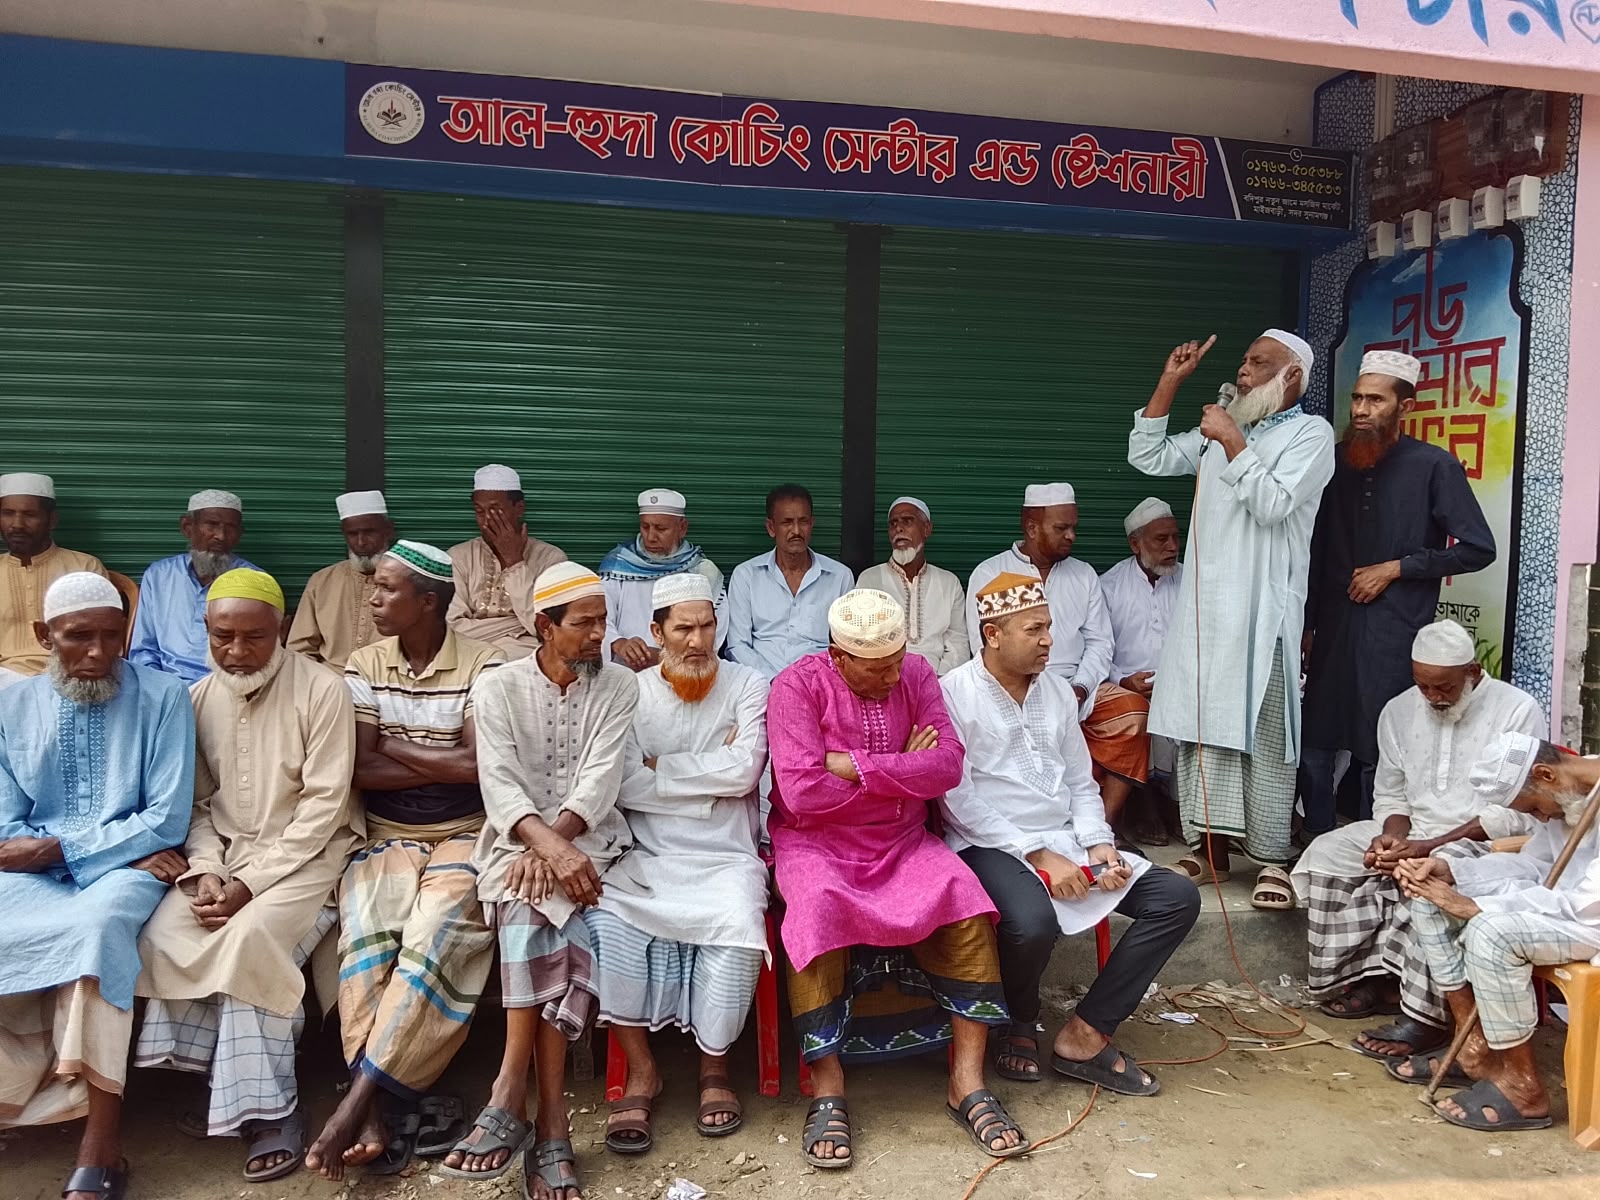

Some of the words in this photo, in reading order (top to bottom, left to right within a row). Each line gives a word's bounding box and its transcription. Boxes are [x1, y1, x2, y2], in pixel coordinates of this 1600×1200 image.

[437, 95, 658, 160] আল-হুদা
[669, 102, 811, 171] কোচিং
[822, 118, 959, 184] সেন্টার
[969, 139, 1041, 186] এন্ড
[1051, 133, 1208, 202] ষ্টেশনারী
[1246, 159, 1344, 180] ০১৭৬৩-৫০৫৩৮৮
[1246, 175, 1342, 196] ০১৭৬৬-৩৪৫৫৩৩
